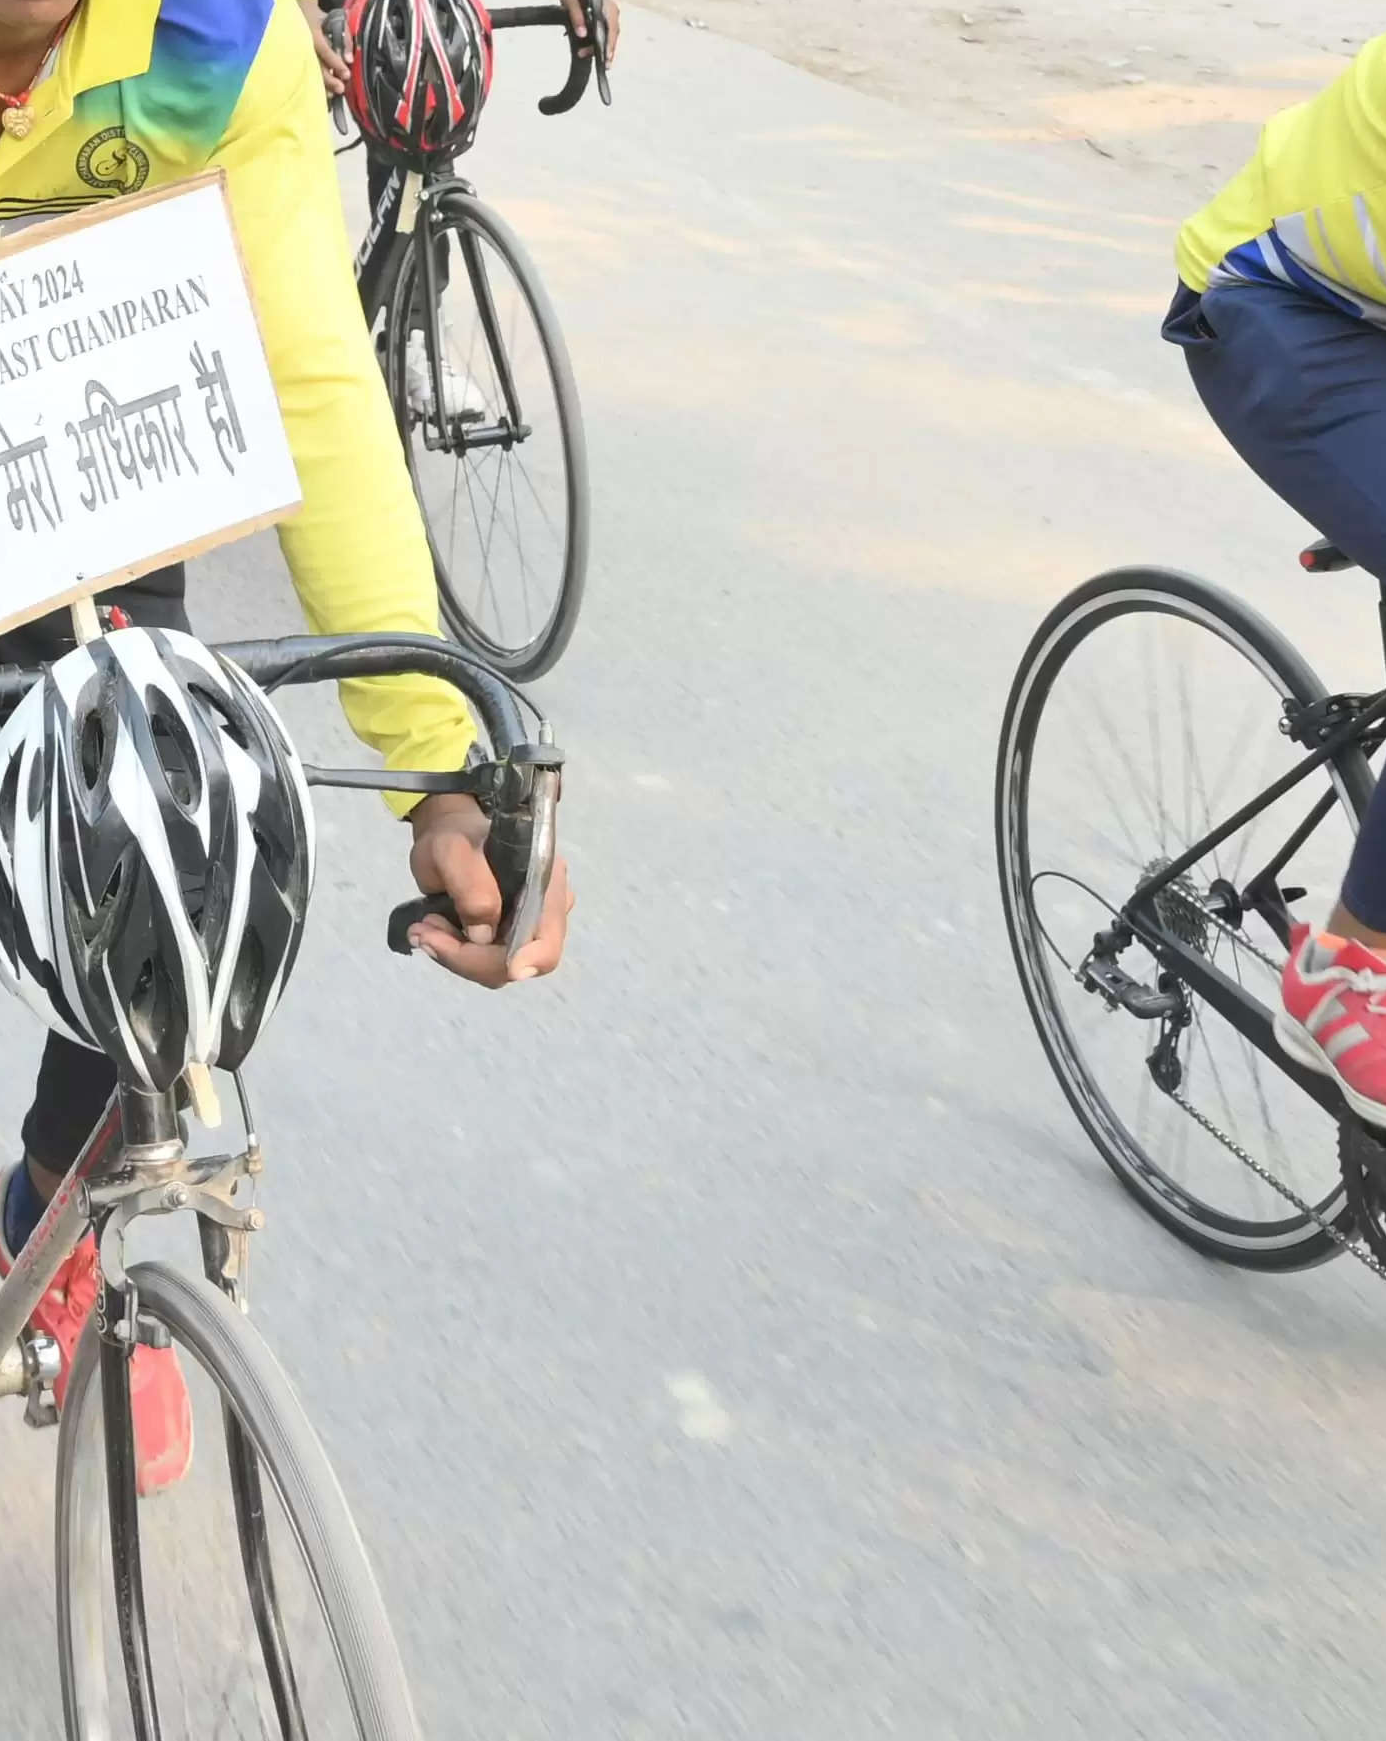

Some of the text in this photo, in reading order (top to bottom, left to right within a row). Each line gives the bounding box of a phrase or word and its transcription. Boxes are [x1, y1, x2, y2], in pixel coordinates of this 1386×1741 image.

[38, 260, 85, 308] 2024
[47, 274, 212, 364] CHAMPARAN
[64, 379, 200, 512] अधिकार
